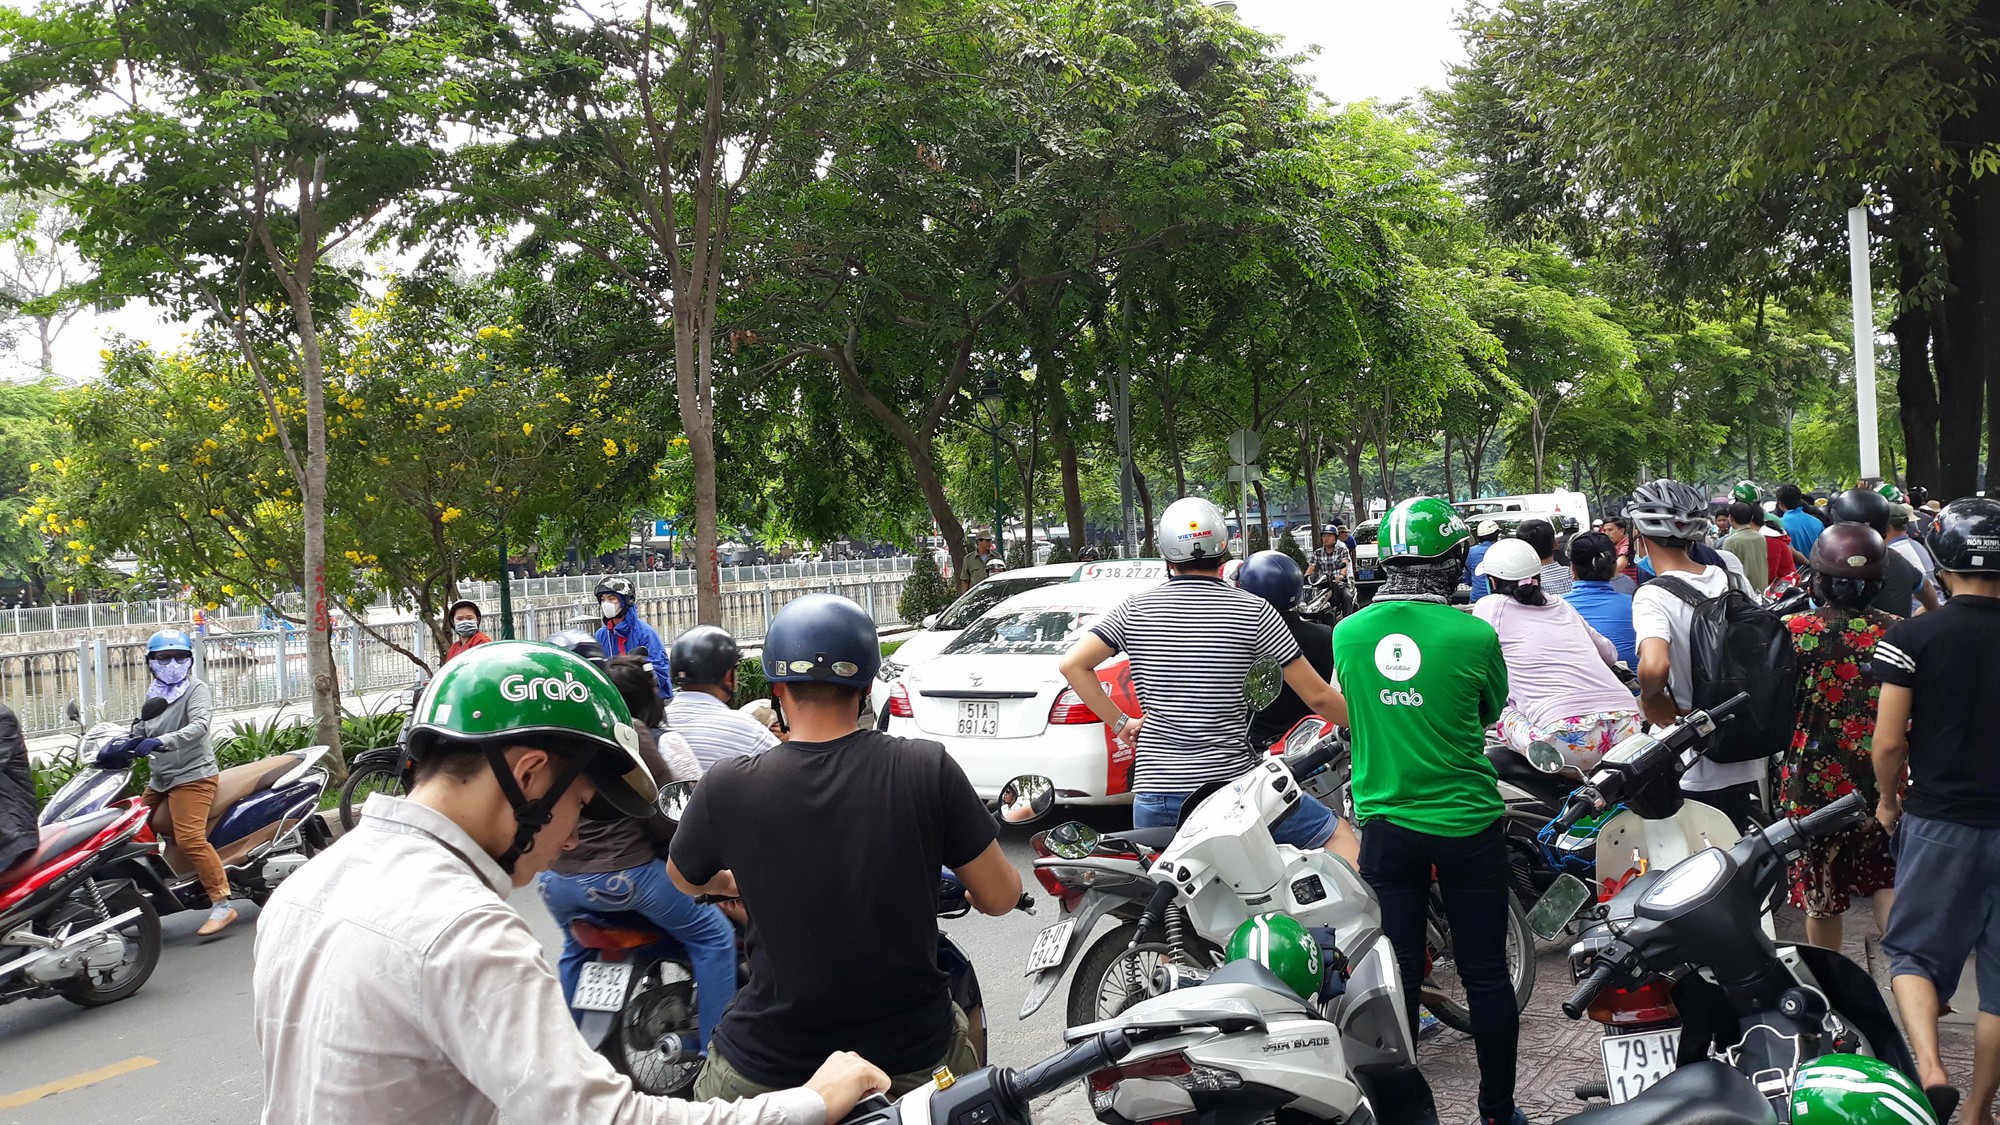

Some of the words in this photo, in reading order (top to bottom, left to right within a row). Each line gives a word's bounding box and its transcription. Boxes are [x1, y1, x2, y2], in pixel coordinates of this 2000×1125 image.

[1177, 530, 1213, 540] VIETBANK
[1105, 567, 1141, 578] 38.27
[1144, 567, 1161, 578] 27
[500, 671, 588, 703] Grab
[1379, 687, 1424, 707] Grab
[958, 719, 996, 735] 691.43
[1035, 923, 1068, 950] 78-U1
[1028, 944, 1060, 971] 7942
[1261, 1040, 1291, 1052] AIR
[1293, 1037, 1330, 1049] BLADE
